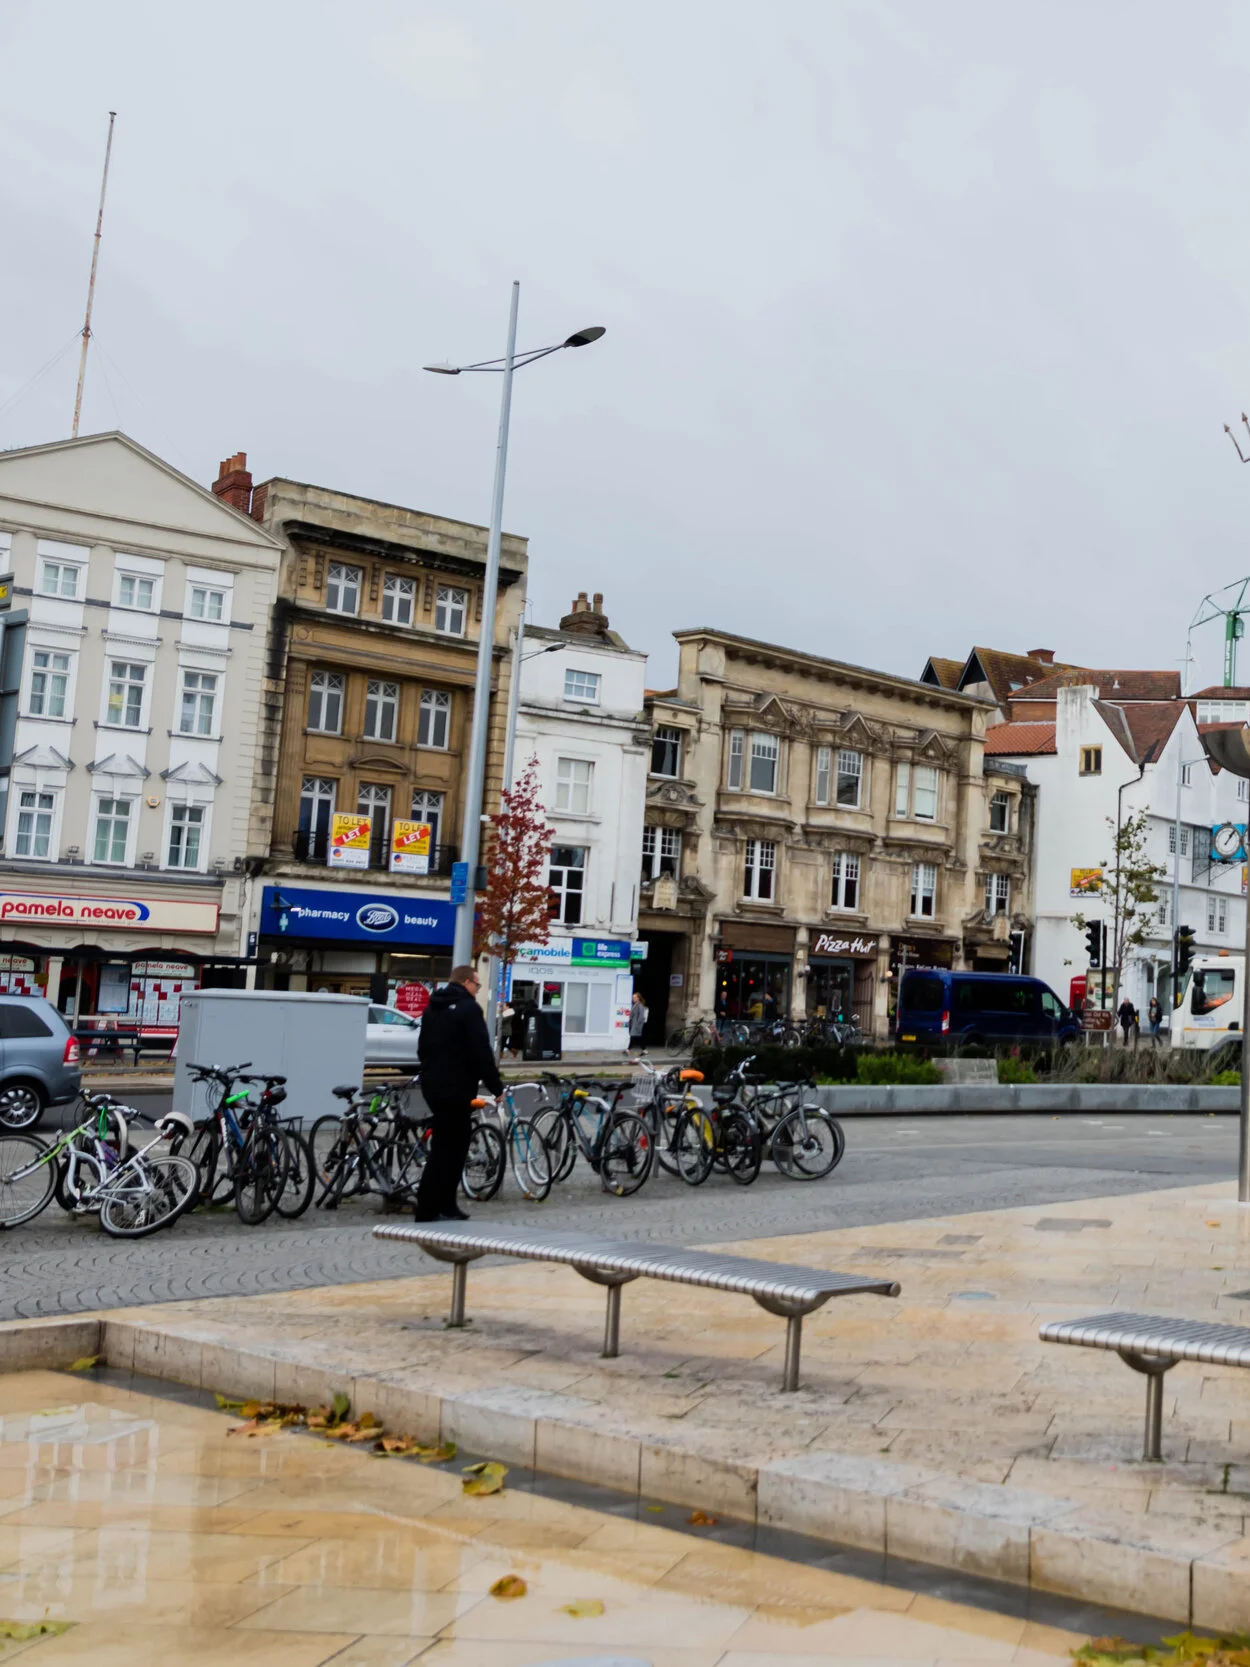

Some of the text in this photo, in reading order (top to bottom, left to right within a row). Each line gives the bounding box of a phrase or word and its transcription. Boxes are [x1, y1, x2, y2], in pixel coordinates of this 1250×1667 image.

[338, 816, 349, 825] TO
[400, 822, 410, 831] TO
[342, 828, 360, 843] LET
[403, 831, 420, 845] LET
[1, 900, 136, 920] pamela neave
[298, 907, 350, 921] pharmacy
[363, 910, 392, 925] Boots
[404, 914, 438, 928] beauty
[815, 934, 876, 954] Pizza Hut
